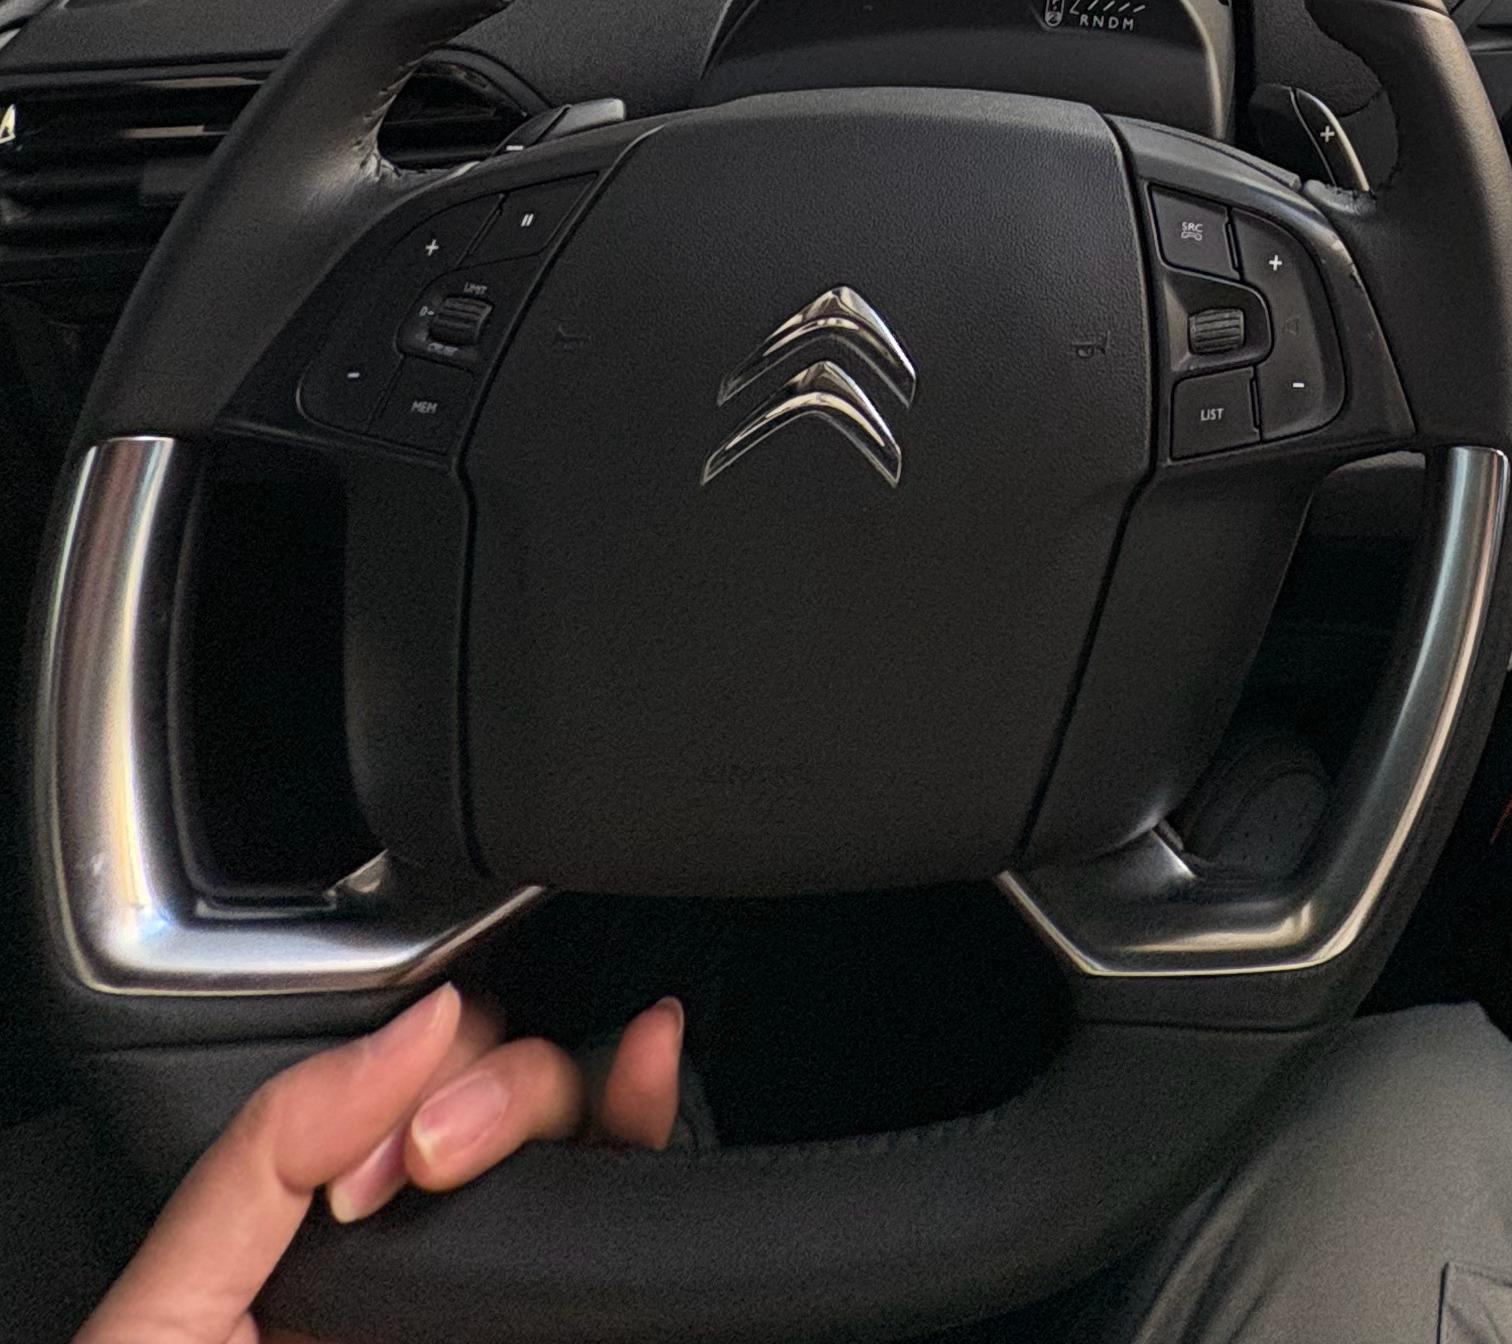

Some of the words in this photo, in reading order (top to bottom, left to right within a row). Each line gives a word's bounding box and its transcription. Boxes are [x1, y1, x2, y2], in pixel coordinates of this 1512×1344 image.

[1181, 221, 1203, 233] SRC
[411, 400, 438, 414] MEM
[1200, 408, 1224, 422] LIST
